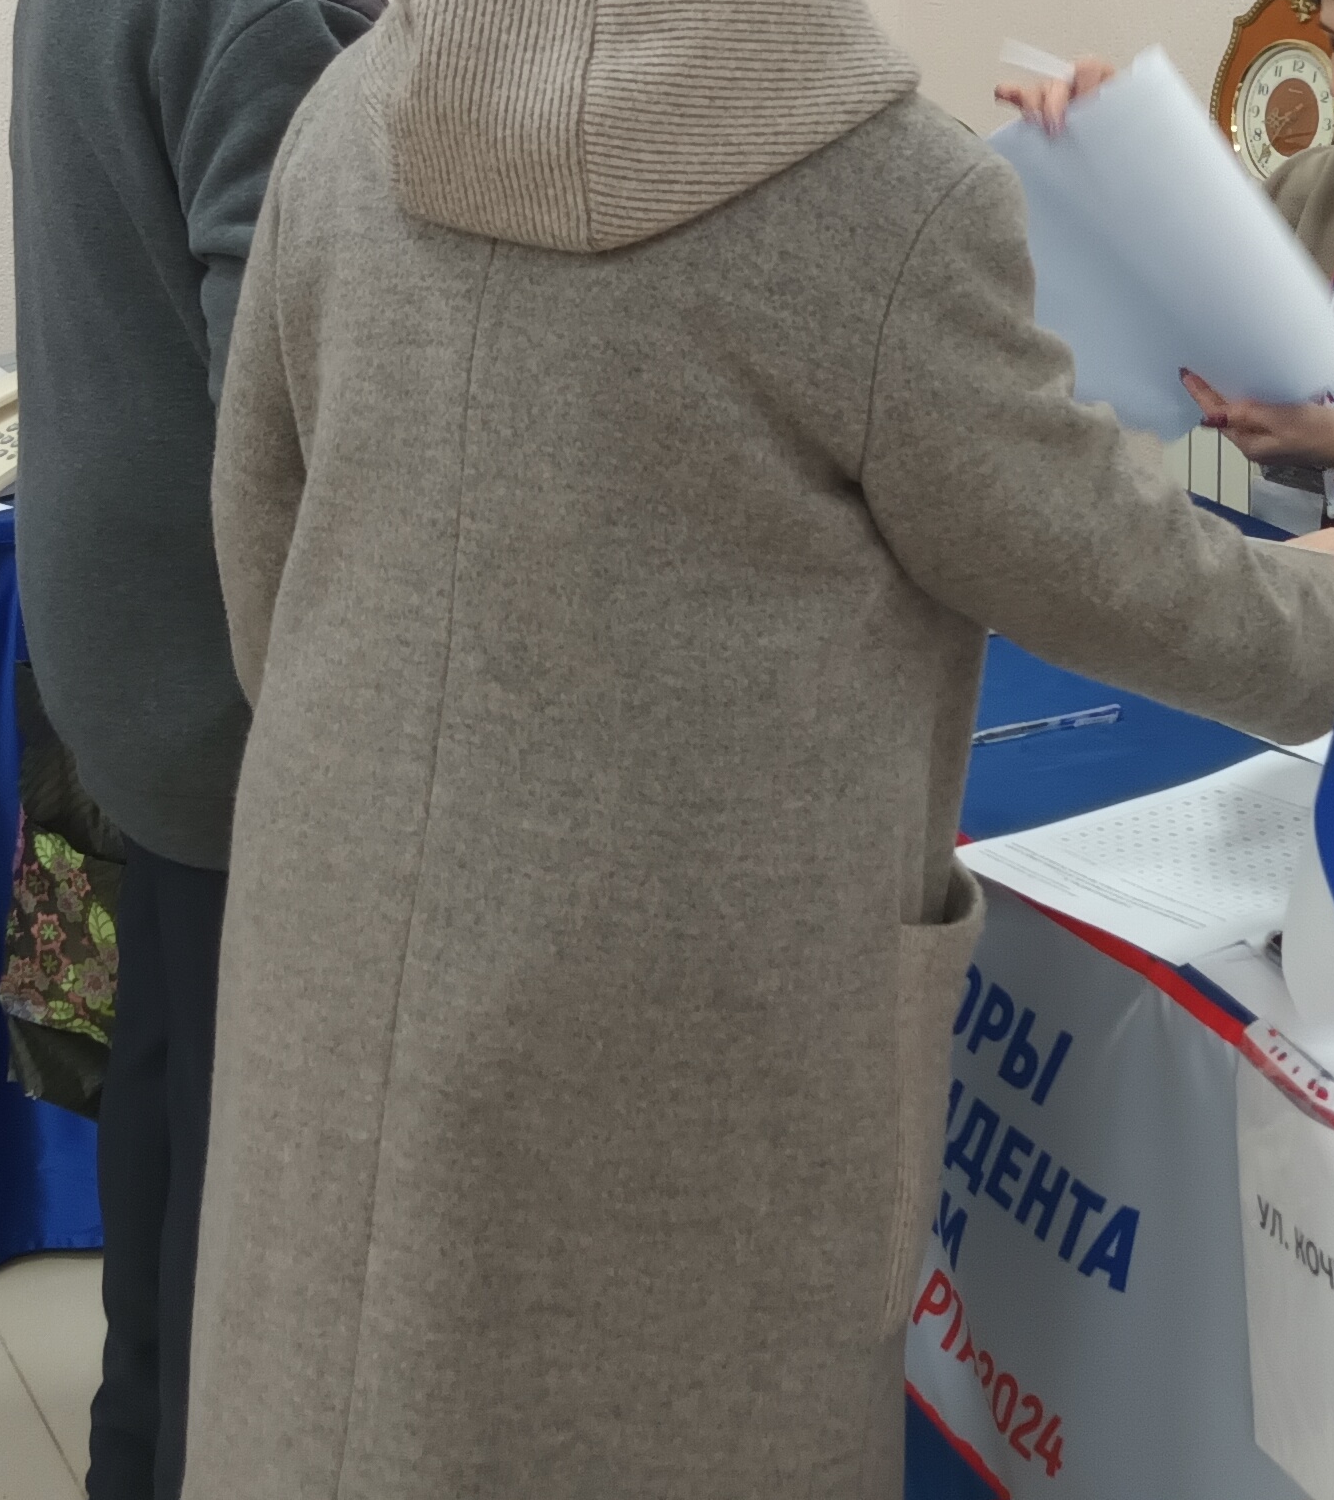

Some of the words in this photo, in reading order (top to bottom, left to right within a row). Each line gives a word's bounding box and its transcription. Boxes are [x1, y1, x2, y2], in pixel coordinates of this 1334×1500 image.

[1275, 66, 1283, 77] 11
[1293, 60, 1305, 73] 12
[1313, 71, 1318, 83] 1
[1258, 83, 1269, 96] 10
[1320, 91, 1329, 103] 2
[1252, 105, 1260, 118] 9
[1322, 118, 1331, 131] 3
[1253, 128, 1262, 141] 8
[1257, 1194, 1289, 1250] УЛ.
